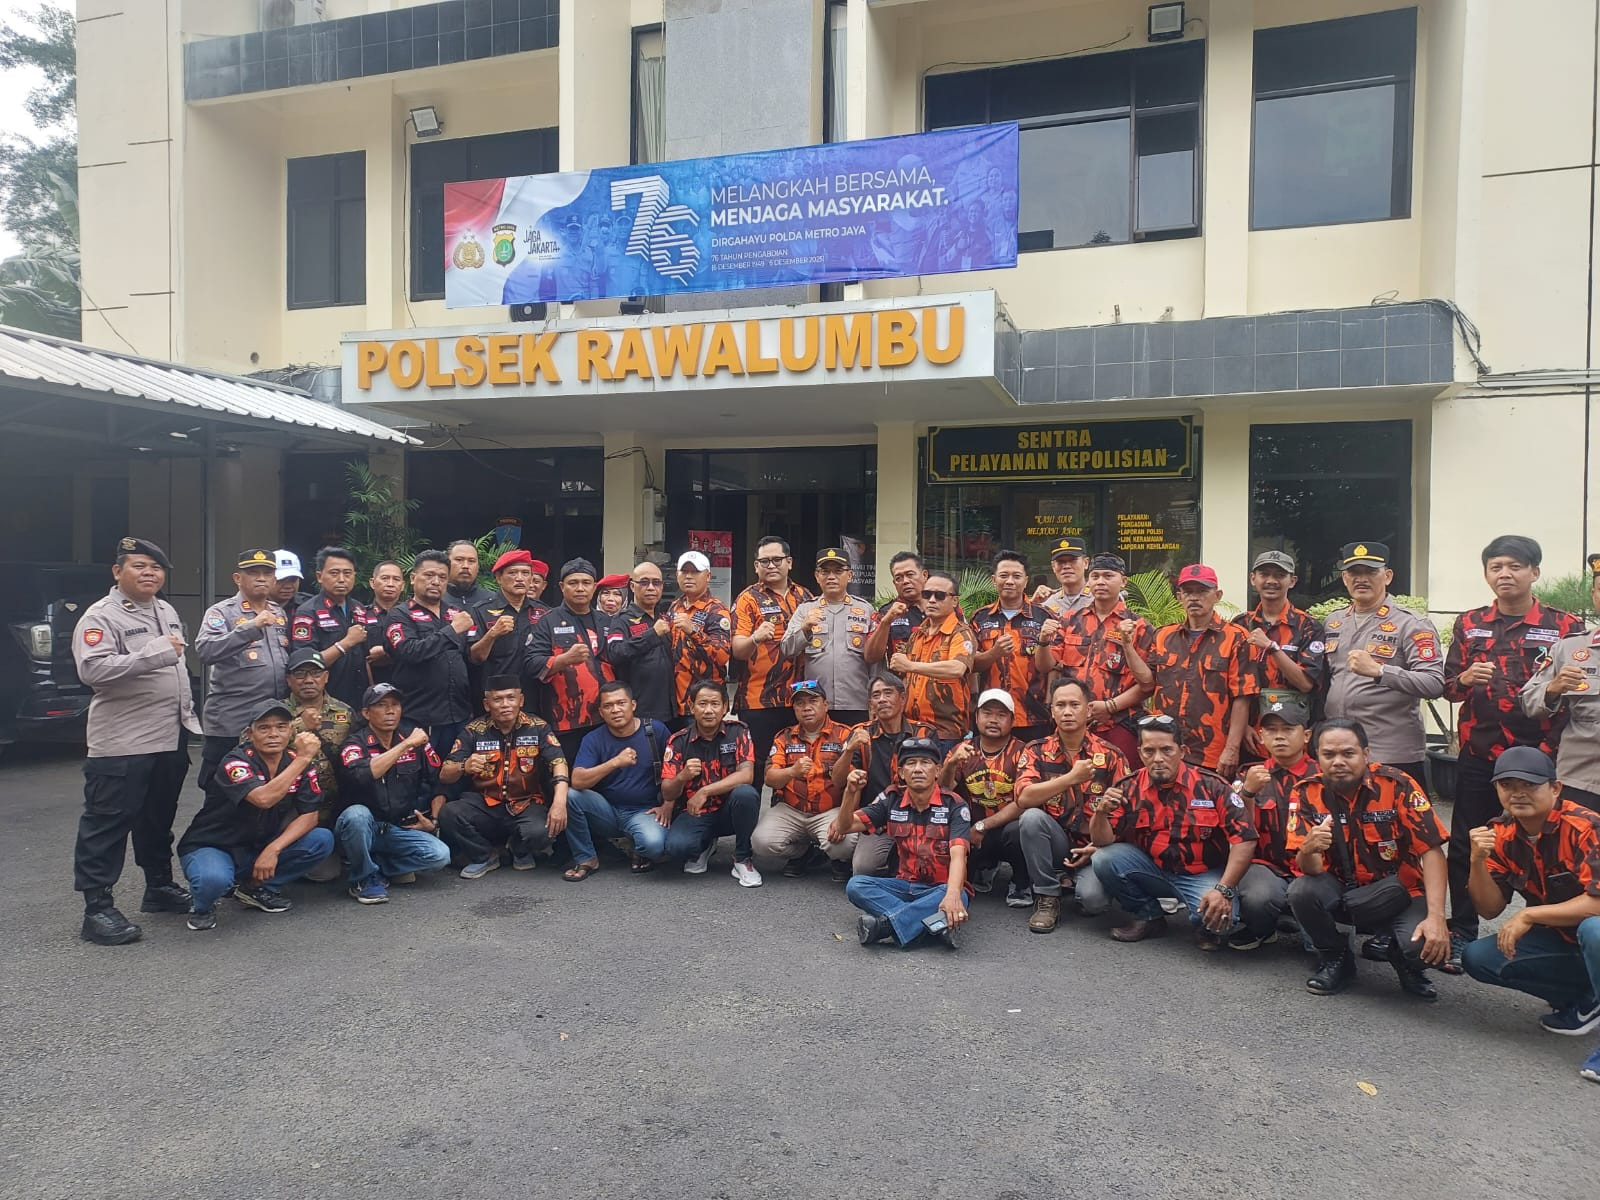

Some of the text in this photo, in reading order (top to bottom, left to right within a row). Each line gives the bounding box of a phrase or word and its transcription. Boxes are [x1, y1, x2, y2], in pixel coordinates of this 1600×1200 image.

[711, 166, 936, 205] MELANGKAH BERSAMA,
[710, 187, 949, 227] MENJAGA MASYARAKAT.
[611, 175, 700, 286] 76
[711, 225, 866, 248] DIRGAHAYU POLDA METRO JAYA
[720, 252, 743, 260] TAHUN
[744, 249, 788, 259] PENGABDIAN
[774, 257, 808, 266] DESEMBER
[358, 306, 965, 390] POLSEK RAWALUMBU
[1017, 429, 1091, 449] SENTRA
[950, 448, 1167, 472] PELAYANAN KEPOLISIAN
[1371, 634, 1397, 644] POLRI
